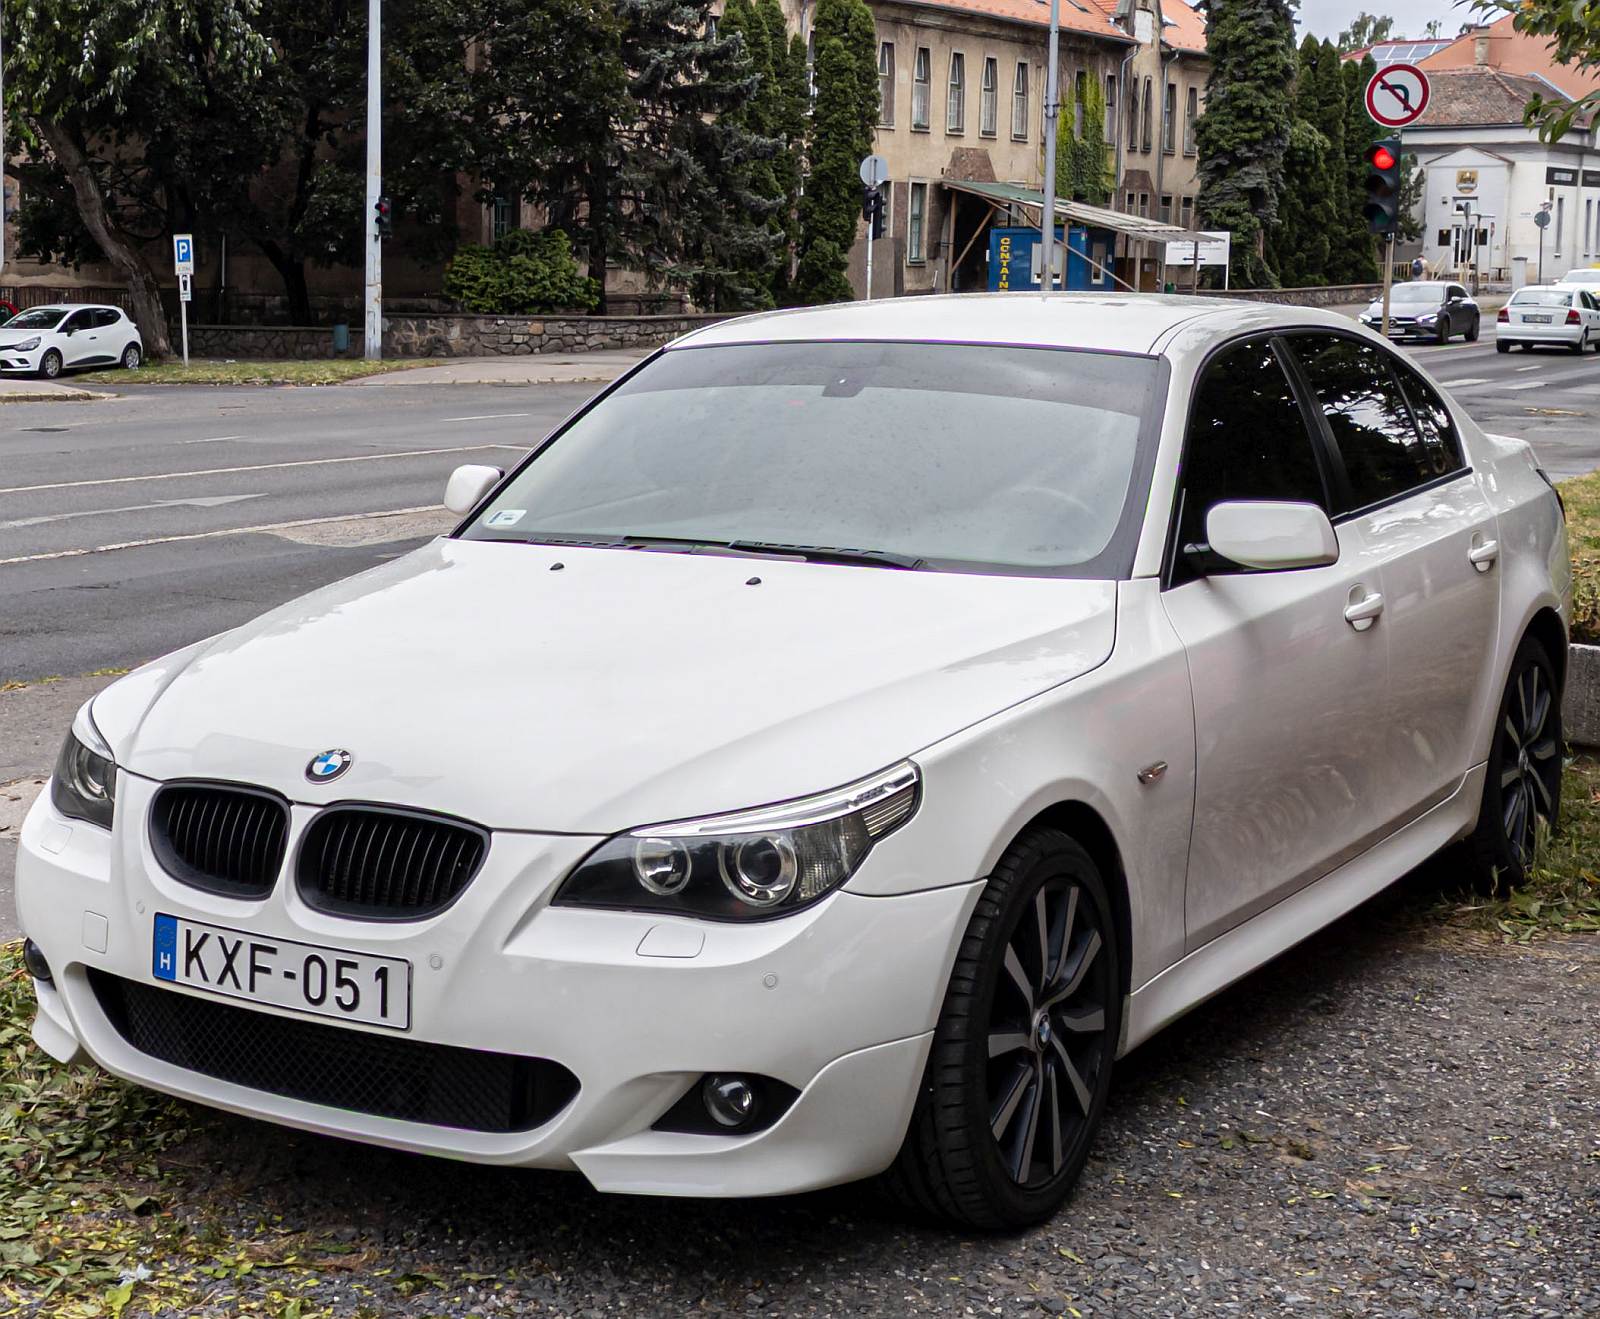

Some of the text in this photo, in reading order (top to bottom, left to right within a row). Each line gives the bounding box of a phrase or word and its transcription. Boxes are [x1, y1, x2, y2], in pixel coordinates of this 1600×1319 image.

[179, 241, 188, 261] P
[999, 237, 1010, 292] CONTAIN
[160, 951, 170, 971] H
[184, 928, 389, 1019] KXF-051
